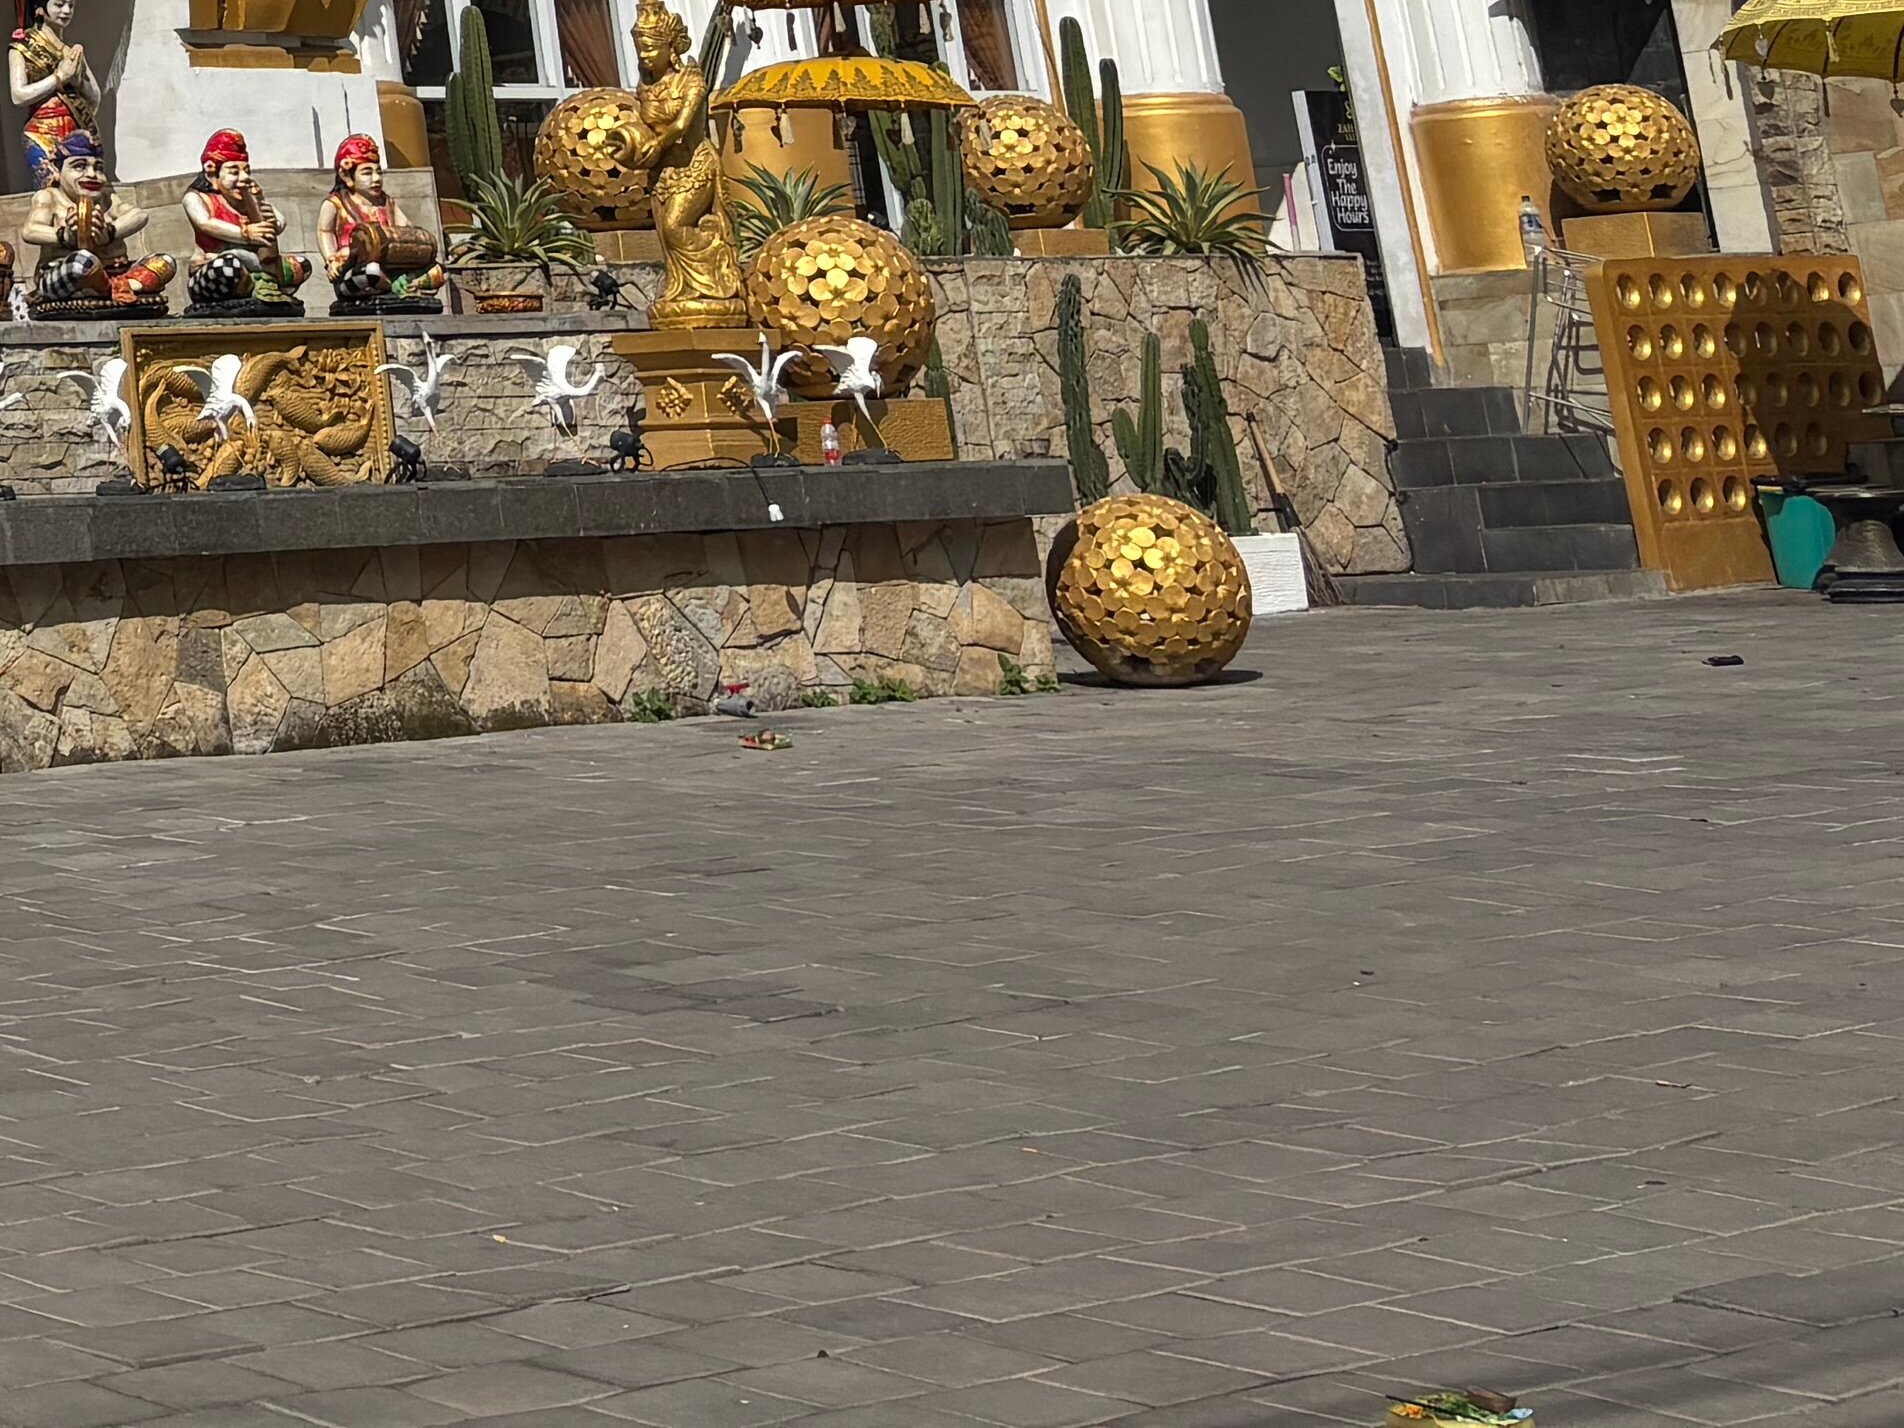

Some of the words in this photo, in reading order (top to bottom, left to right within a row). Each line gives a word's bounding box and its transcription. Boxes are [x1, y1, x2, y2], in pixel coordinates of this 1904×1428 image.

[1327, 158, 1358, 180] Enjoy
[1336, 178, 1358, 195] The
[1331, 190, 1369, 212] Happy
[1336, 206, 1370, 225] Hours
